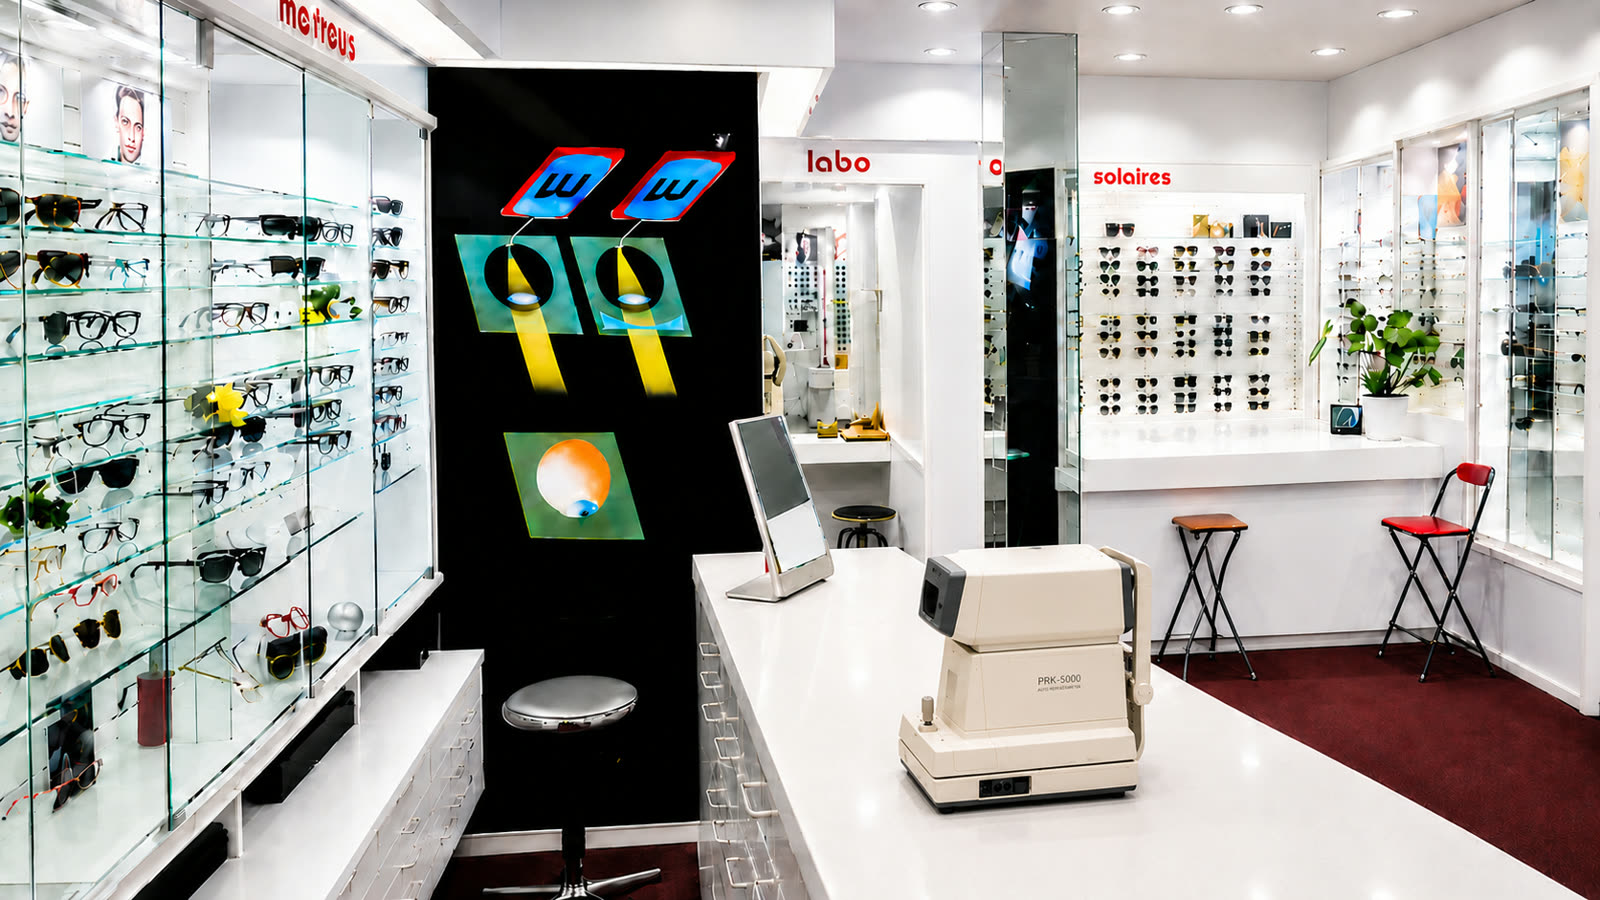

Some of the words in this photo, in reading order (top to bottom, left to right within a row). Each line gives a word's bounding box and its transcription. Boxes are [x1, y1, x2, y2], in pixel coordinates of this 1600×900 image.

[807, 149, 871, 173] labo
[1093, 167, 1172, 186] solaires
[1037, 674, 1082, 686] PRK-5000
